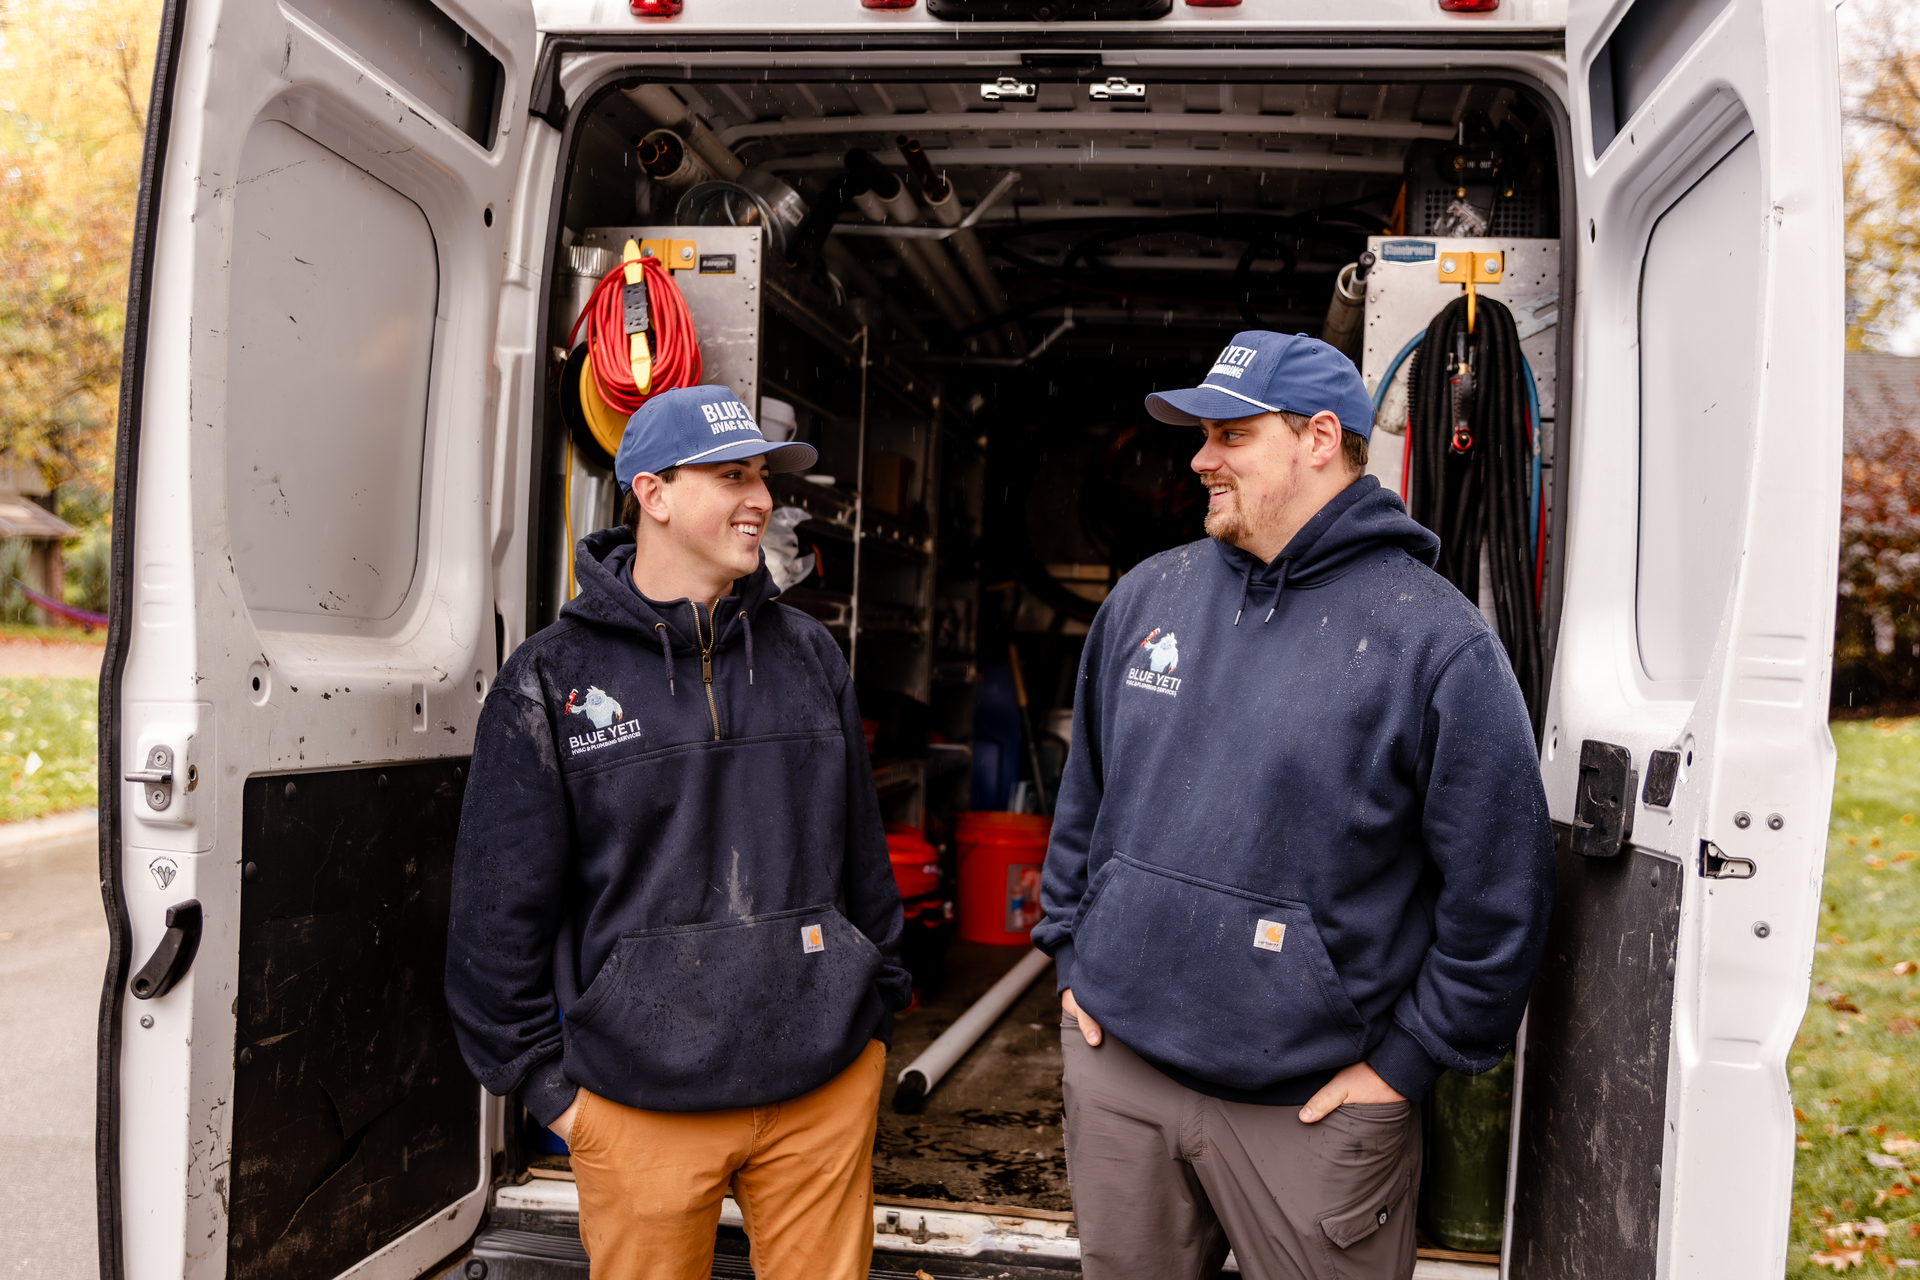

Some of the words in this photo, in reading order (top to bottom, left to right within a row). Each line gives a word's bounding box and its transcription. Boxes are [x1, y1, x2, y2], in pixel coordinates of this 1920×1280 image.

[1222, 345, 1258, 367] YETI
[701, 401, 746, 423] BLUE
[710, 421, 737, 435] HVAC
[736, 420, 745, 430] &
[1129, 668, 1155, 683] BLUE
[1156, 673, 1182, 690] YETI
[569, 730, 607, 748] BLUE
[607, 719, 640, 738] YETI
[591, 739, 617, 750] PLUMBING
[617, 731, 641, 742] SERVICES
